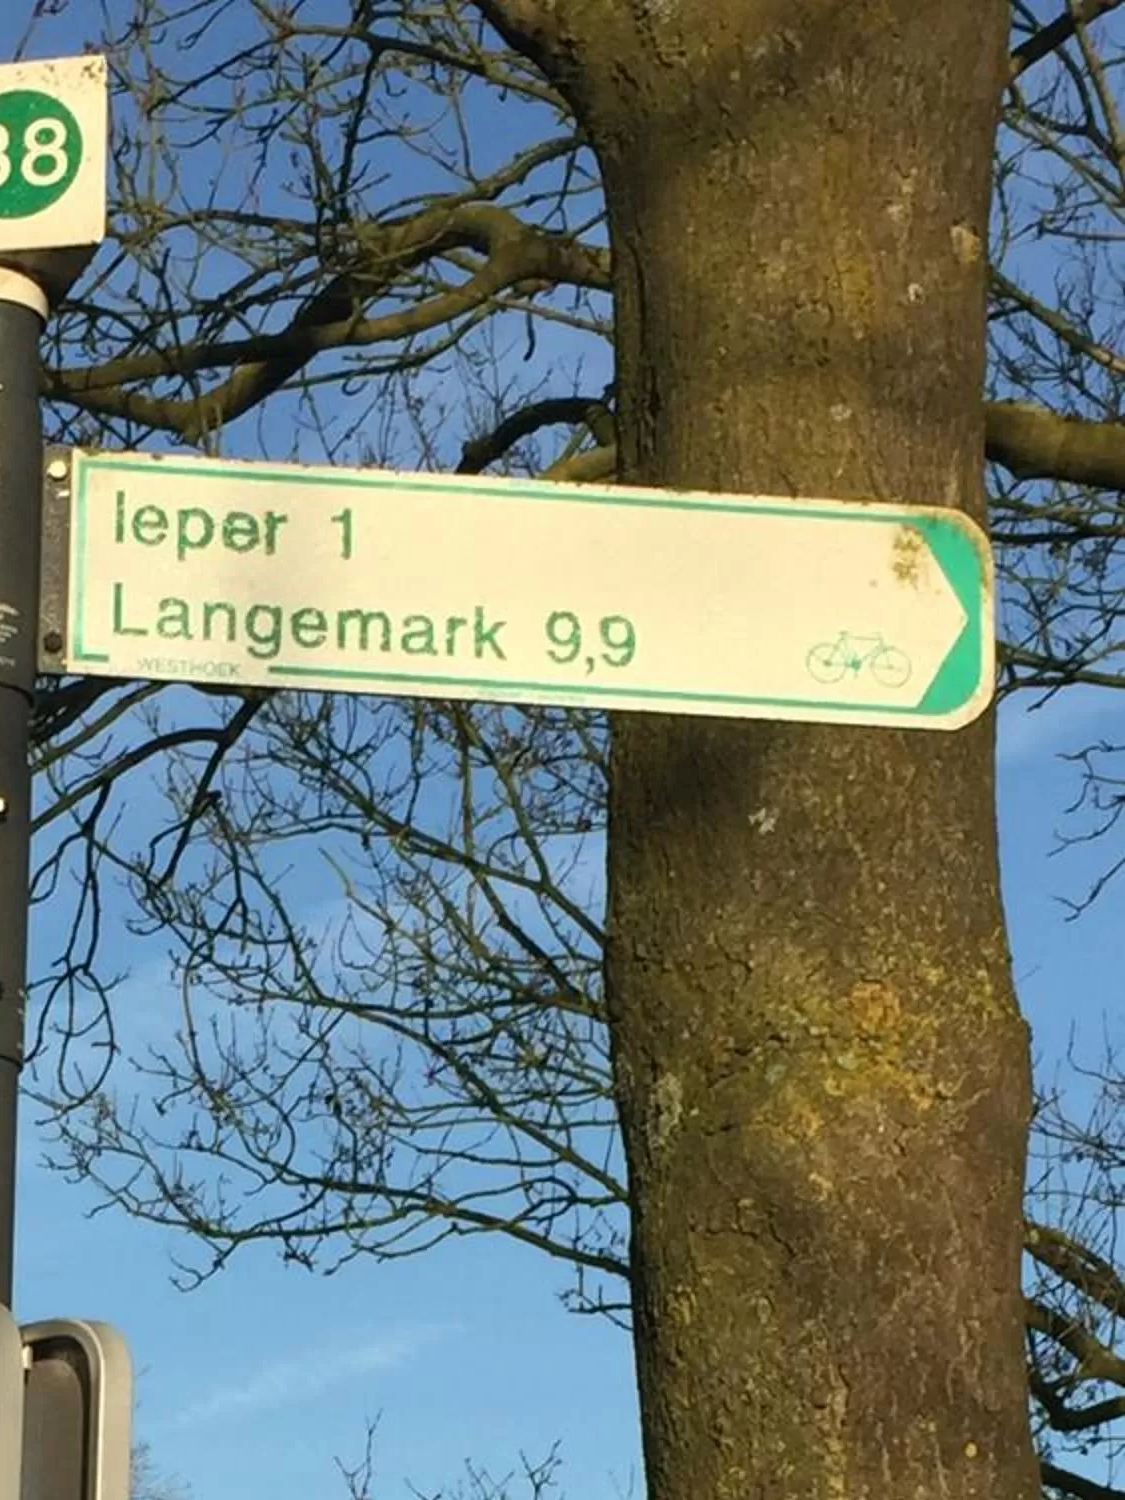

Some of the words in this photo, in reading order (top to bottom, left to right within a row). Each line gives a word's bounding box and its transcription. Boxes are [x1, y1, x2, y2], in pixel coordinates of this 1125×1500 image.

[113, 490, 289, 562] Ieper
[329, 507, 355, 559] 1
[110, 581, 507, 660] Langemark
[545, 612, 637, 677] 9,9
